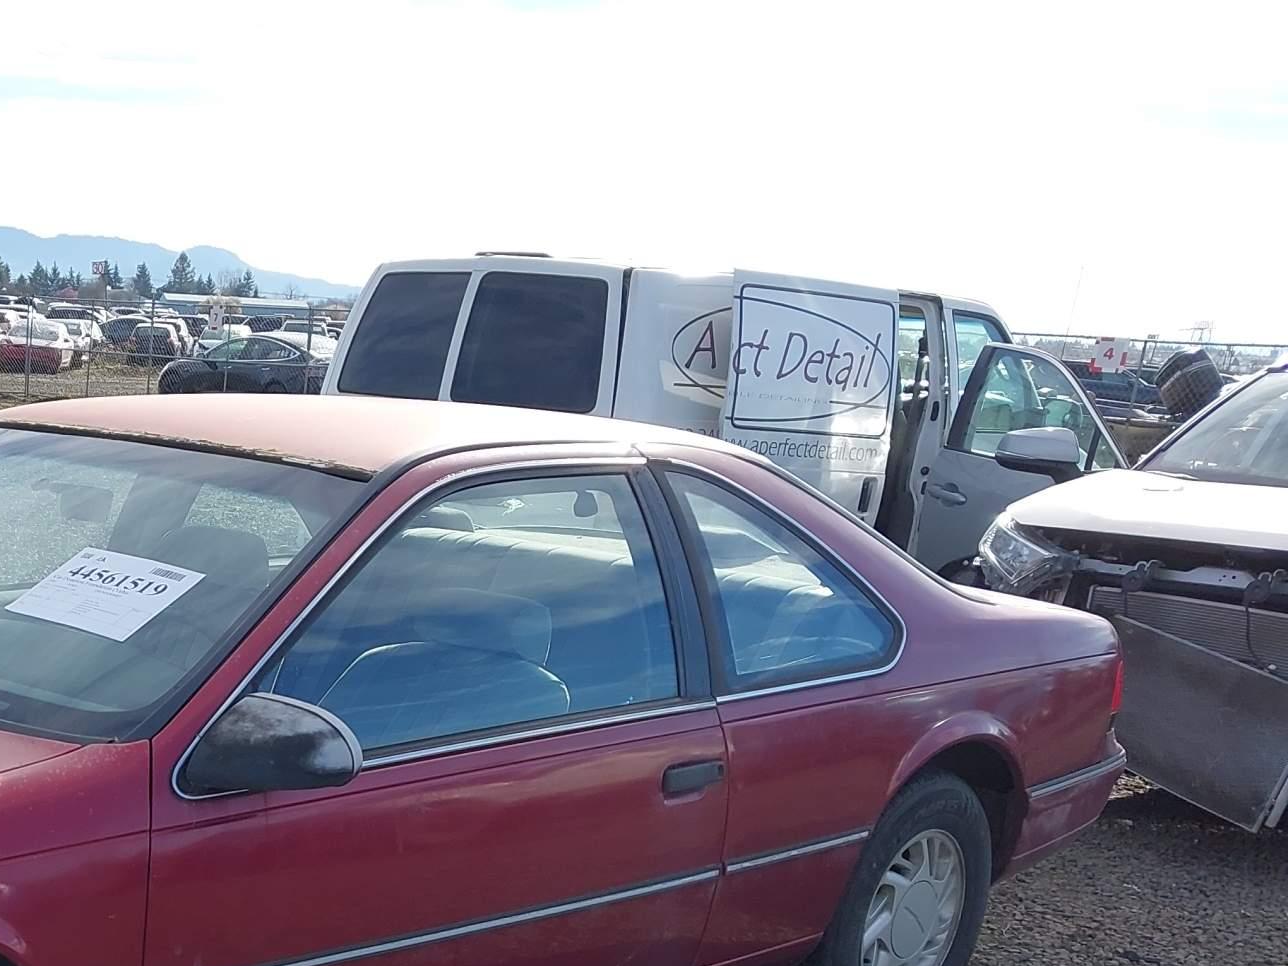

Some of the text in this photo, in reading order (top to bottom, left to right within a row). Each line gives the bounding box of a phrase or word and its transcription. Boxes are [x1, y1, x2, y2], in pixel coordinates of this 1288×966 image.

[776, 331, 882, 392] Detail
[1103, 347, 1114, 361] 4
[725, 437, 879, 461] waperfectdetail.com
[68, 565, 169, 597] 44561519
